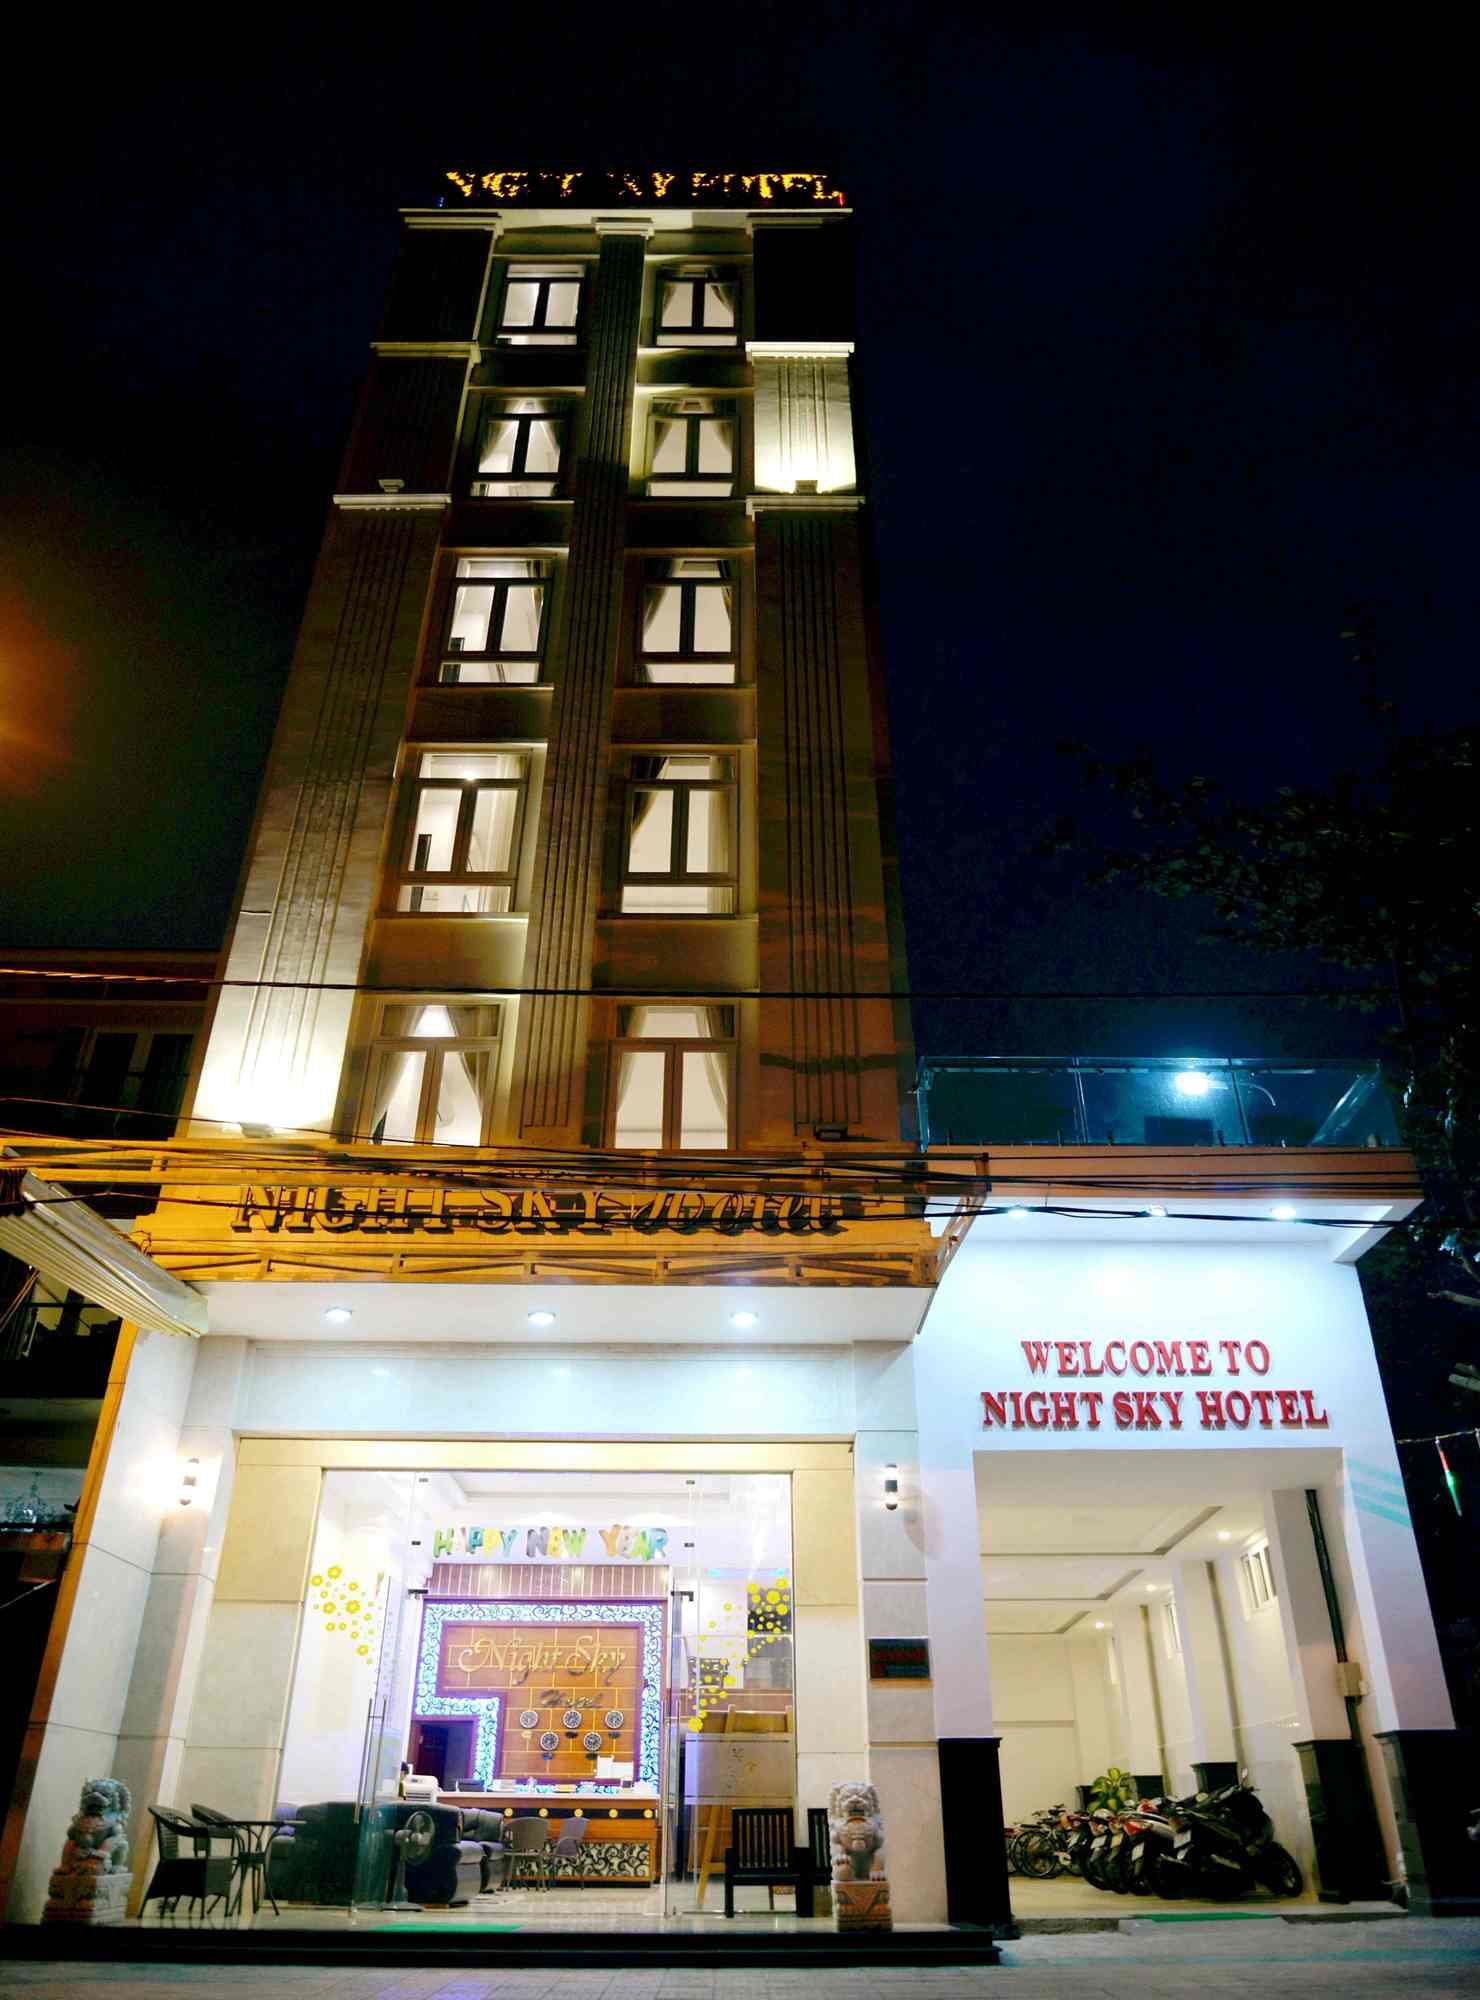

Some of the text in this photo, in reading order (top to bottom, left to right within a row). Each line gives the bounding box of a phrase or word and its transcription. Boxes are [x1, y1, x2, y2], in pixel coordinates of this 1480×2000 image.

[1021, 1340, 1271, 1377] WELCOME TO
[980, 1389, 1330, 1429] NIGHT SKY HOTEL
[433, 1524, 669, 1561] HAPPY NEW YEAR
[458, 1635, 626, 1686] Night Sky
